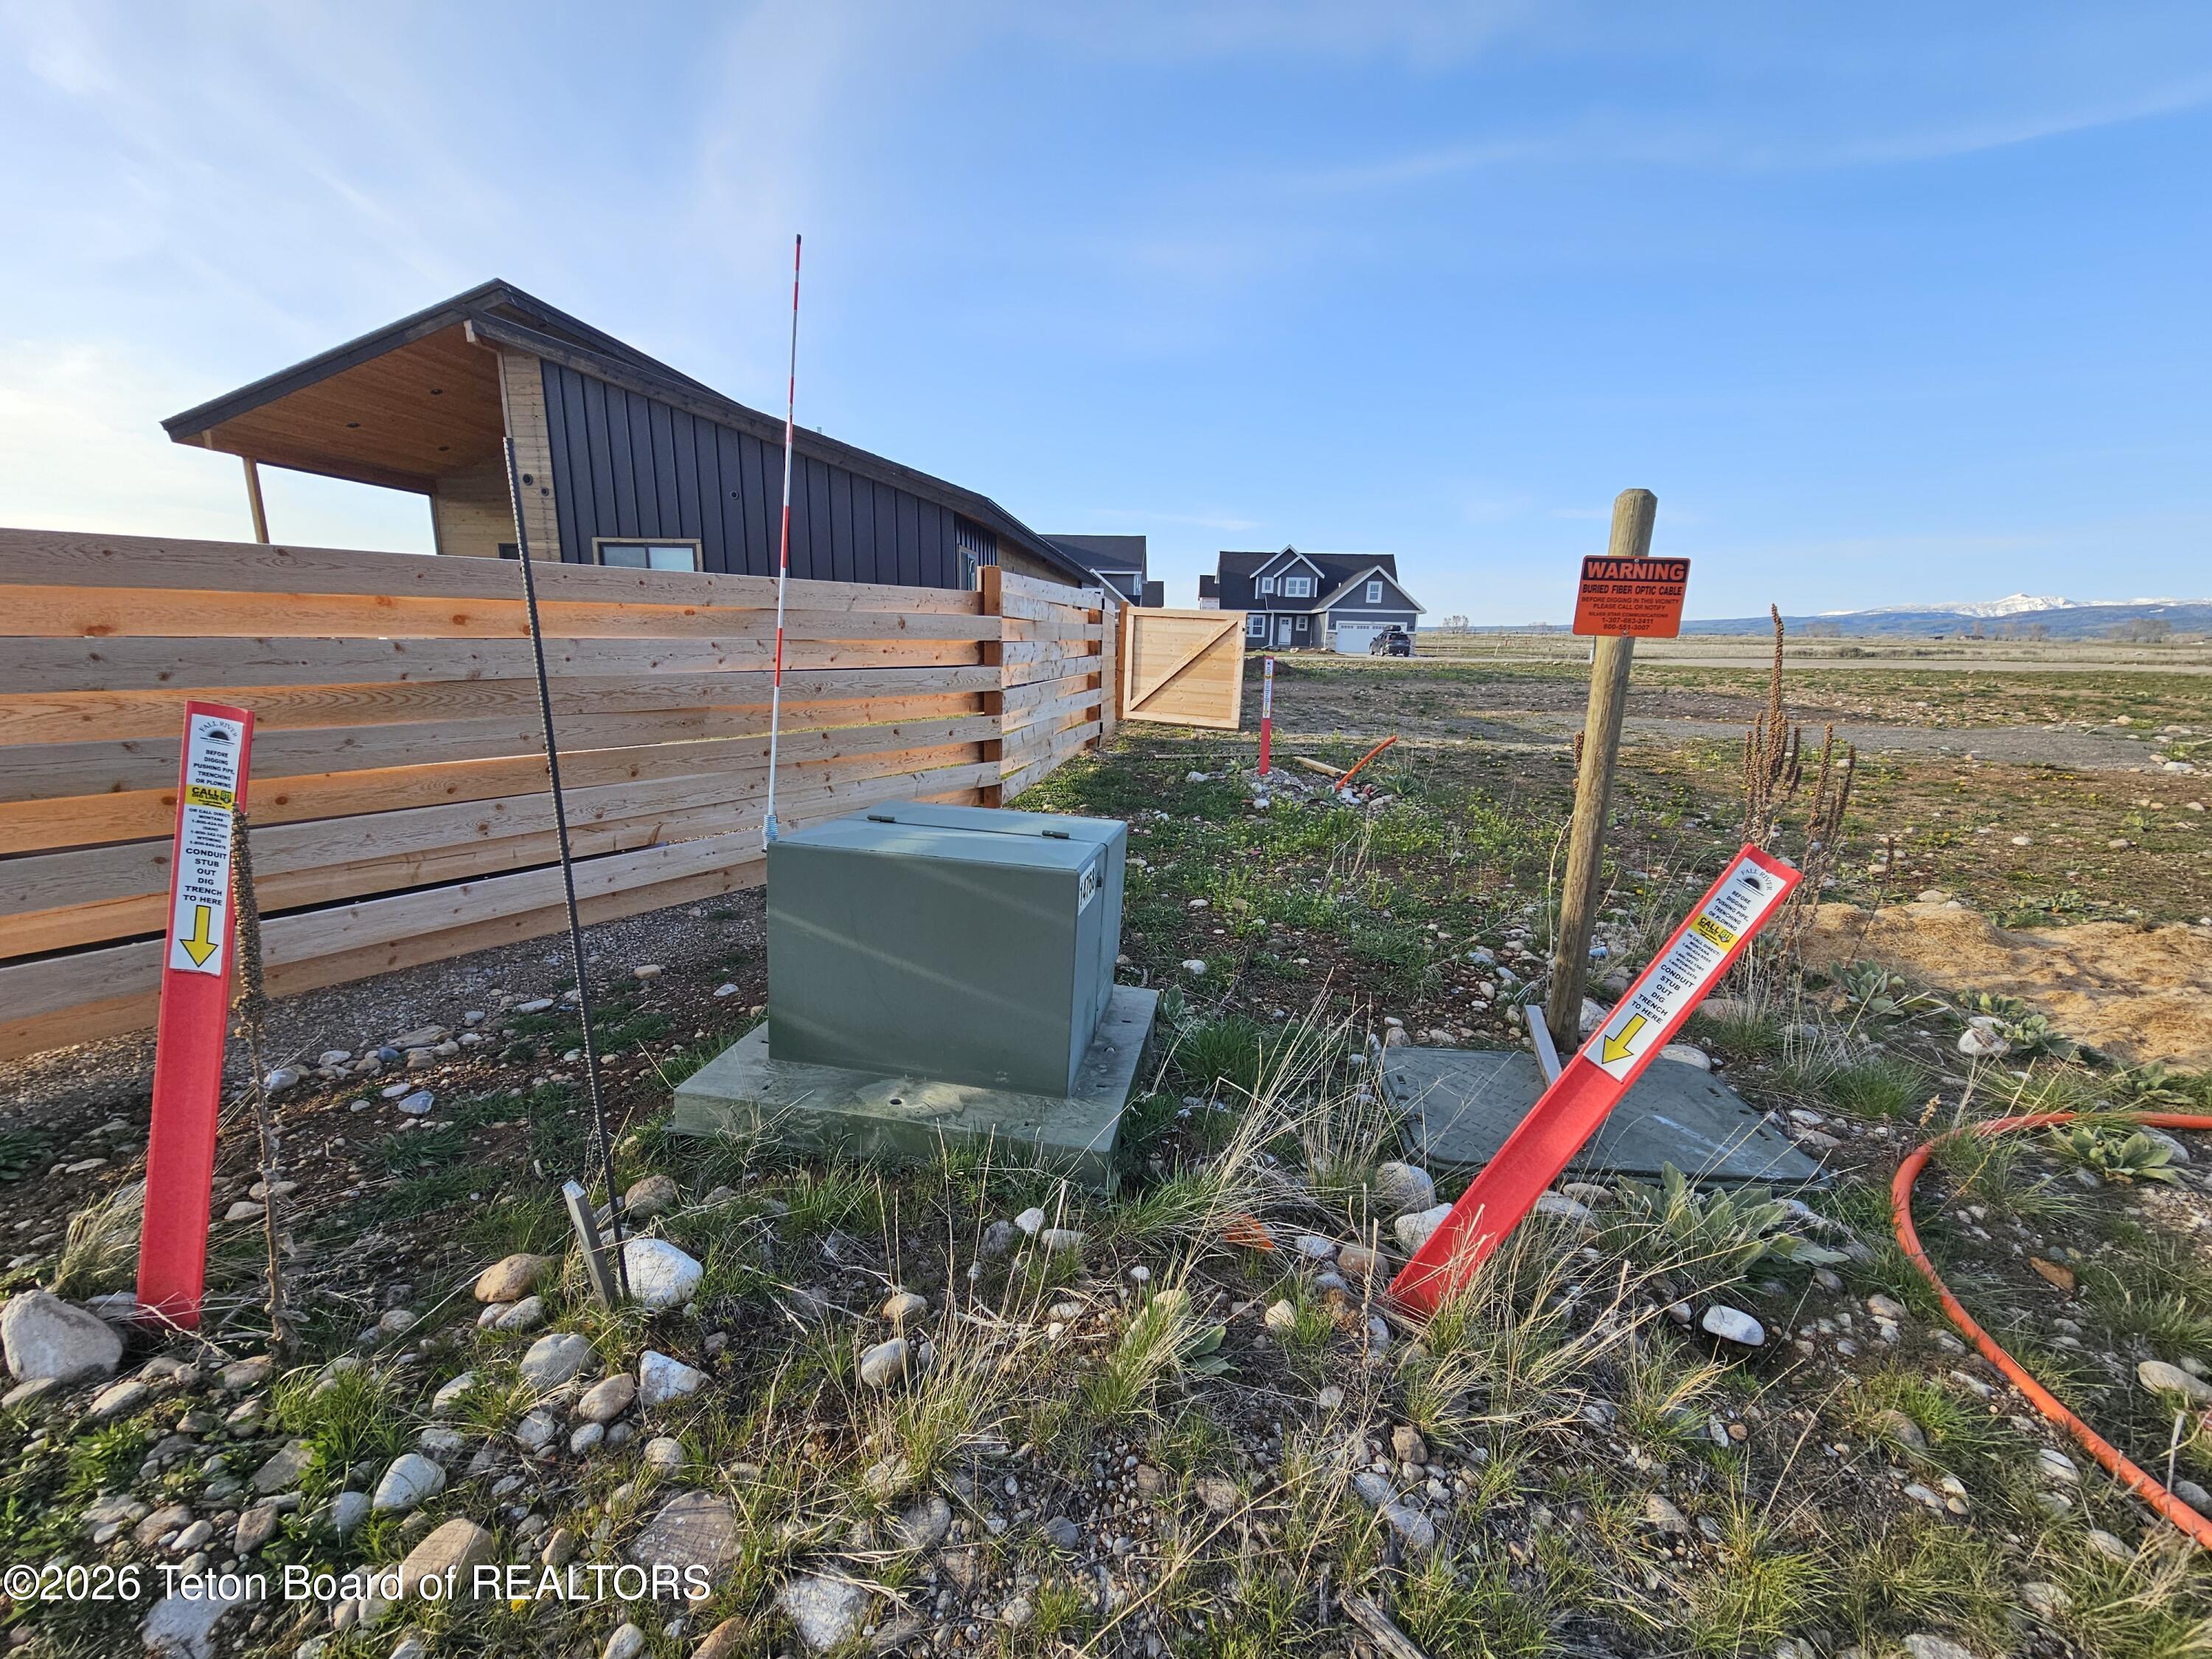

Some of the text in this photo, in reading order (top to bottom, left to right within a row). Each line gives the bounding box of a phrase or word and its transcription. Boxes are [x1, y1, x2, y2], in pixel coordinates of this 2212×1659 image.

[1587, 562, 1685, 580] WARNING
[1582, 584, 1683, 596] BURIED FIBER OPTIC CABLE
[199, 720, 238, 737] FALL RIVER
[205, 749, 229, 758] BEFORE
[193, 762, 221, 771] PUSHING
[204, 757, 229, 766] DIGGING
[198, 771, 231, 781] TRENCHING
[206, 779, 232, 789] PLOWING
[192, 787, 220, 797] CALL
[185, 848, 228, 860] CONDUIT
[195, 858, 220, 867] STUB
[196, 868, 216, 876] OUT
[198, 877, 214, 886] DIG
[1740, 868, 1758, 876] FALL
[1759, 871, 1773, 891] RIVER
[184, 885, 223, 897] TRENCH
[1731, 890, 1752, 905] BEFORE
[199, 897, 223, 906] HERE
[1716, 897, 1736, 914] PUSHING
[1726, 895, 1747, 911] DIGGING
[1714, 905, 1742, 925] TRENCHING
[1697, 922, 1706, 931] DIG
[1700, 917, 1719, 933] CALL
[1715, 915, 1738, 932] PLOWING
[1692, 936, 1703, 946] CALL
[1689, 941, 1710, 956] MONTANA
[1686, 951, 1700, 962] IDAHO
[1675, 958, 1697, 973] WYOMING
[1660, 964, 1694, 989] CONDUIT
[1660, 975, 1681, 991] STUB
[1656, 984, 1673, 997] OUT
[1651, 991, 1666, 1004] DIG
[1638, 993, 1669, 1016] TRENCH
[1632, 1000, 1663, 1024] TO HERE
